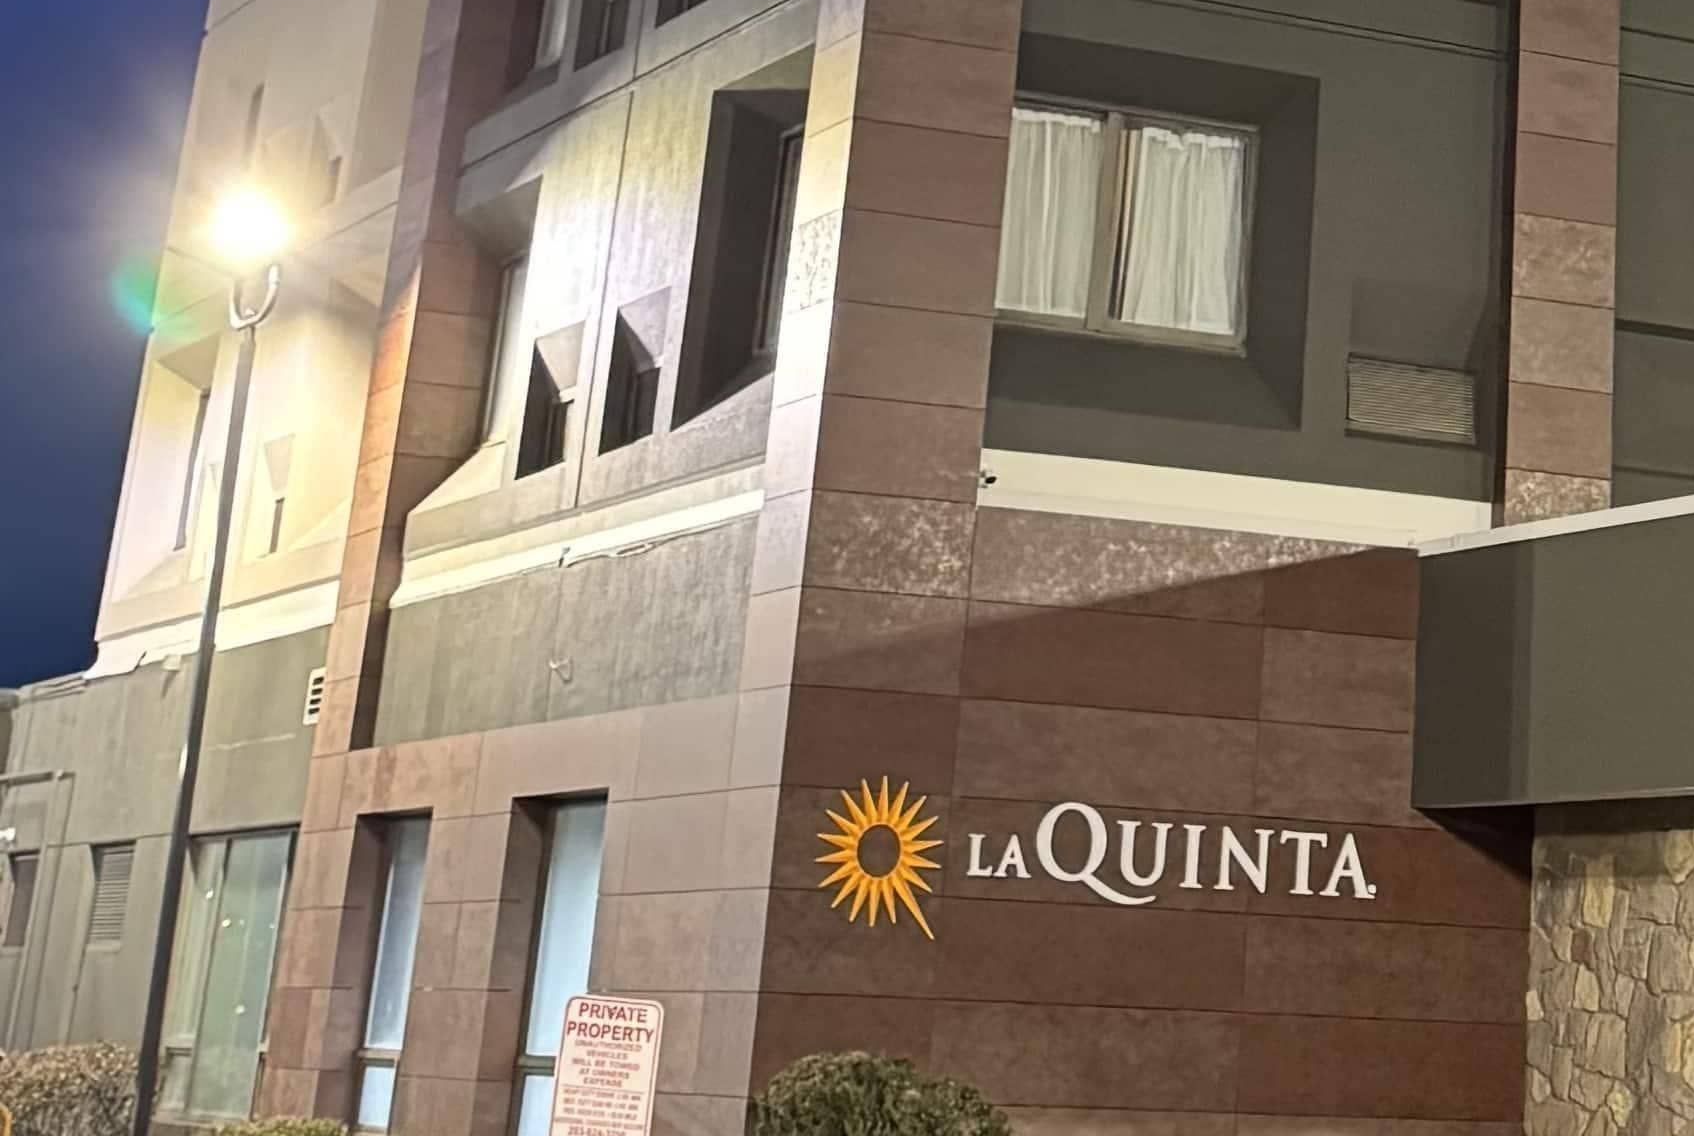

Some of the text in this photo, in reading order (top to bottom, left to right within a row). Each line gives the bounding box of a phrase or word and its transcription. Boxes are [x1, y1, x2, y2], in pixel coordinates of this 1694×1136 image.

[966, 801, 1375, 905] LA QUINTA
[578, 1002, 648, 1023] PRIVATE
[566, 1021, 654, 1043] PROPERTY
[575, 1039, 642, 1052] UNAUTHORIZED
